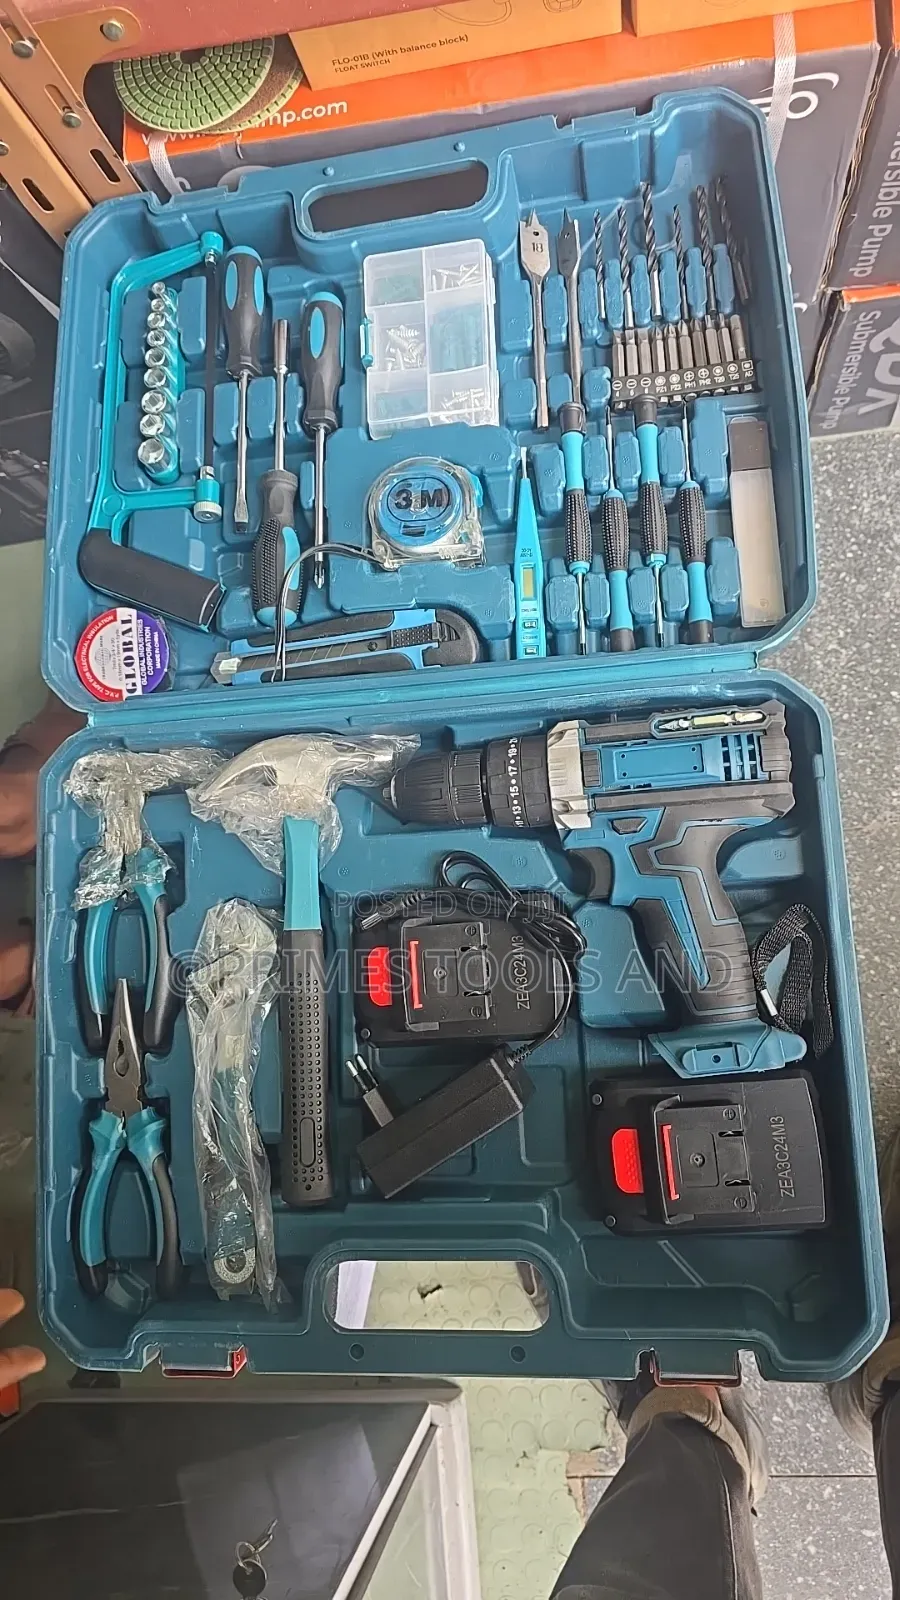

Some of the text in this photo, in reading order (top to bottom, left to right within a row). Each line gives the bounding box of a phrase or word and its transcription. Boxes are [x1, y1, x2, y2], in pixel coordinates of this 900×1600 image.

[332, 33, 469, 67] FLO-01B (With balance block)
[334, 58, 391, 74] FLOAT SWITCH
[531, 242, 544, 253] 18
[848, 223, 894, 278] Pump
[834, 310, 882, 395] Submersible
[655, 385, 667, 393] PZ1
[670, 383, 682, 391] PZ2
[699, 378, 711, 386] PH2
[714, 375, 726, 383] T20
[728, 373, 740, 381] T25
[819, 396, 851, 430] Pump
[80, 640, 91, 671] ELECTRICAL
[87, 614, 115, 640] INSULATION
[121, 614, 138, 694] GLOBAL
[137, 618, 148, 686] GLOBAL INDUSTRIES
[144, 626, 154, 676] CORPORATION
[155, 649, 161, 657] IN
[507, 747, 518, 759] 19
[507, 765, 519, 777] 17
[510, 785, 519, 797] 15
[512, 805, 522, 817] 13
[510, 934, 531, 1010] ZEA3C24M3
[769, 1114, 795, 1199] ZEA3C24M3
